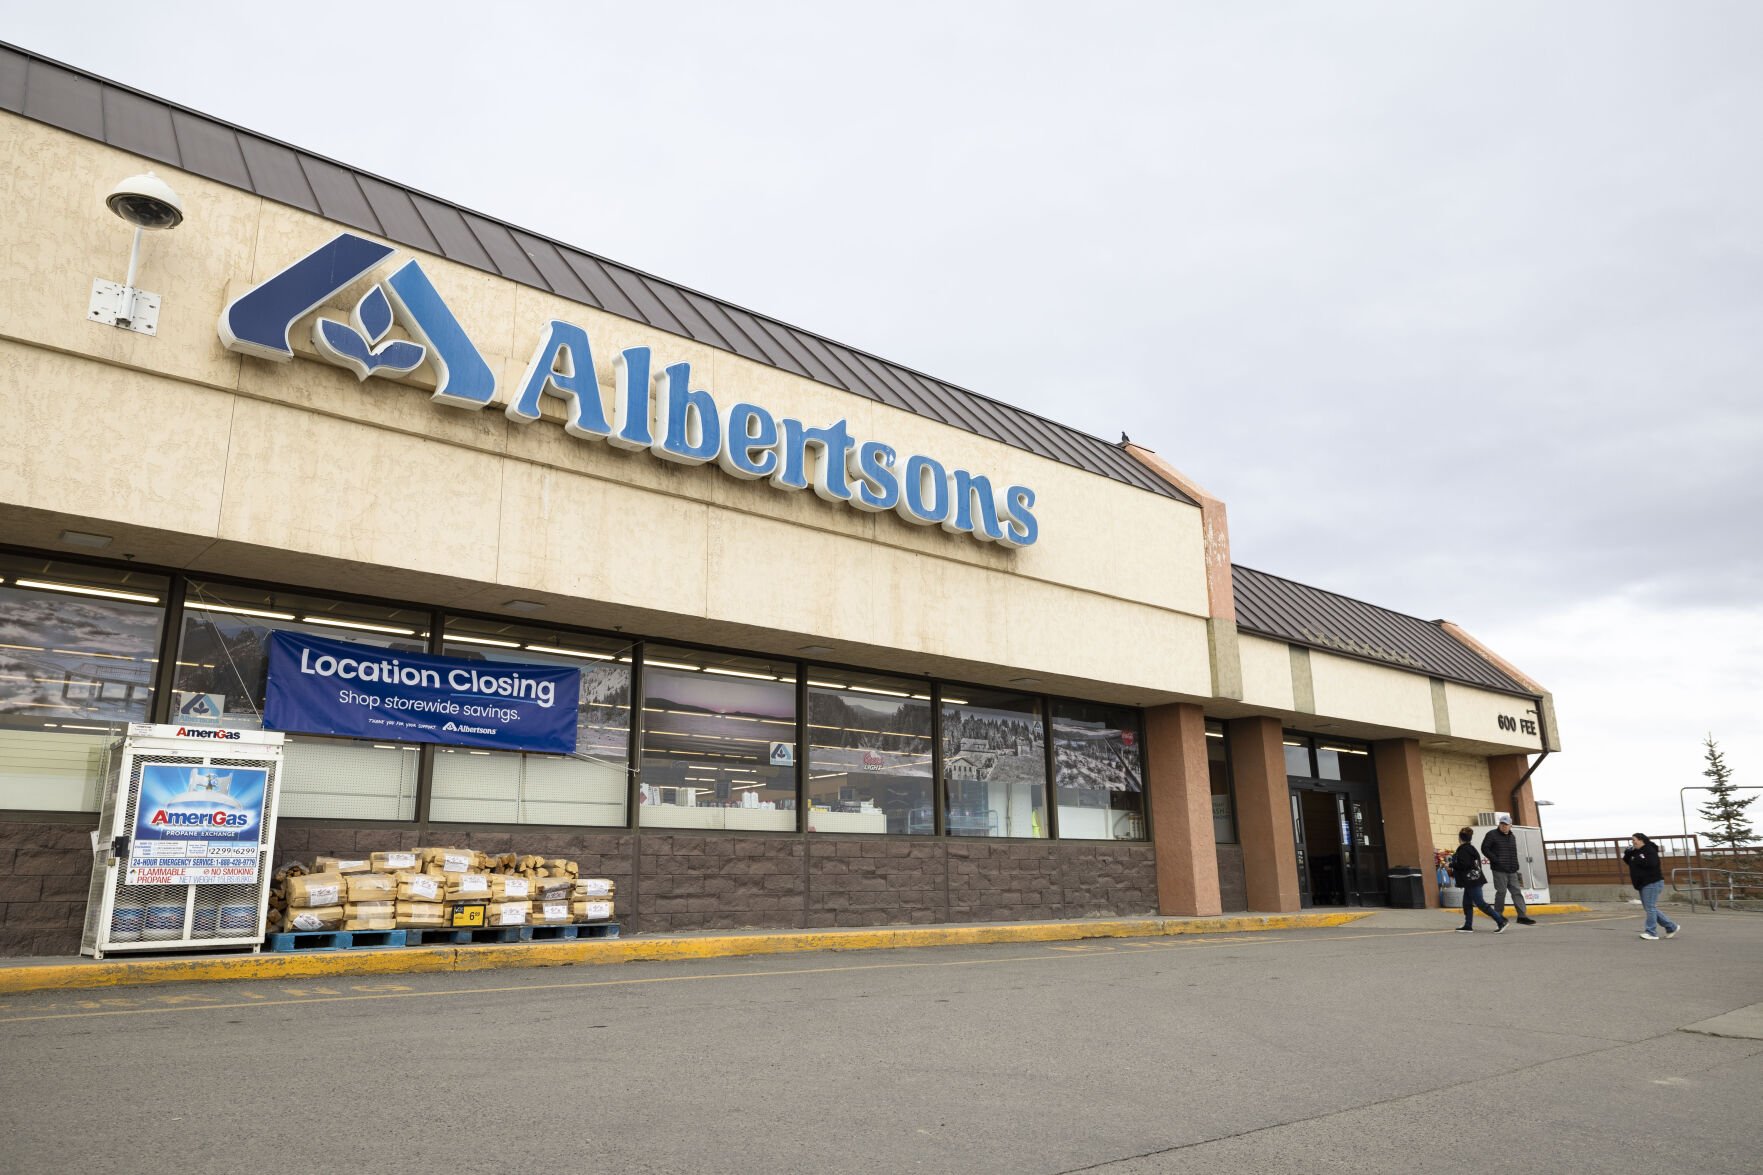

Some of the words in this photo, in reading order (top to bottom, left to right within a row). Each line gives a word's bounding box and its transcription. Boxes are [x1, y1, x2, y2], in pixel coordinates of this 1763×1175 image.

[506, 319, 1039, 549] Albertsons
[301, 648, 440, 688] Location
[448, 669, 555, 708] Closing
[339, 690, 381, 710] Shop
[385, 696, 460, 715] storewide
[463, 703, 521, 723] savings.
[457, 724, 497, 735] Albertsons
[1498, 714, 1517, 732] 600
[1519, 718, 1537, 736] FEE
[176, 727, 241, 739] AmeriGas
[151, 809, 248, 826] AmeriGas
[133, 858, 158, 866] 24-HOUR
[159, 858, 192, 866] EMERGENCY
[138, 867, 187, 876] FLAMMABLE
[211, 868, 221, 876] NO
[223, 868, 254, 876] SMOKING
[137, 875, 172, 884] PROPANE
[179, 875, 192, 884] NET
[193, 875, 216, 884] WEIGHT
